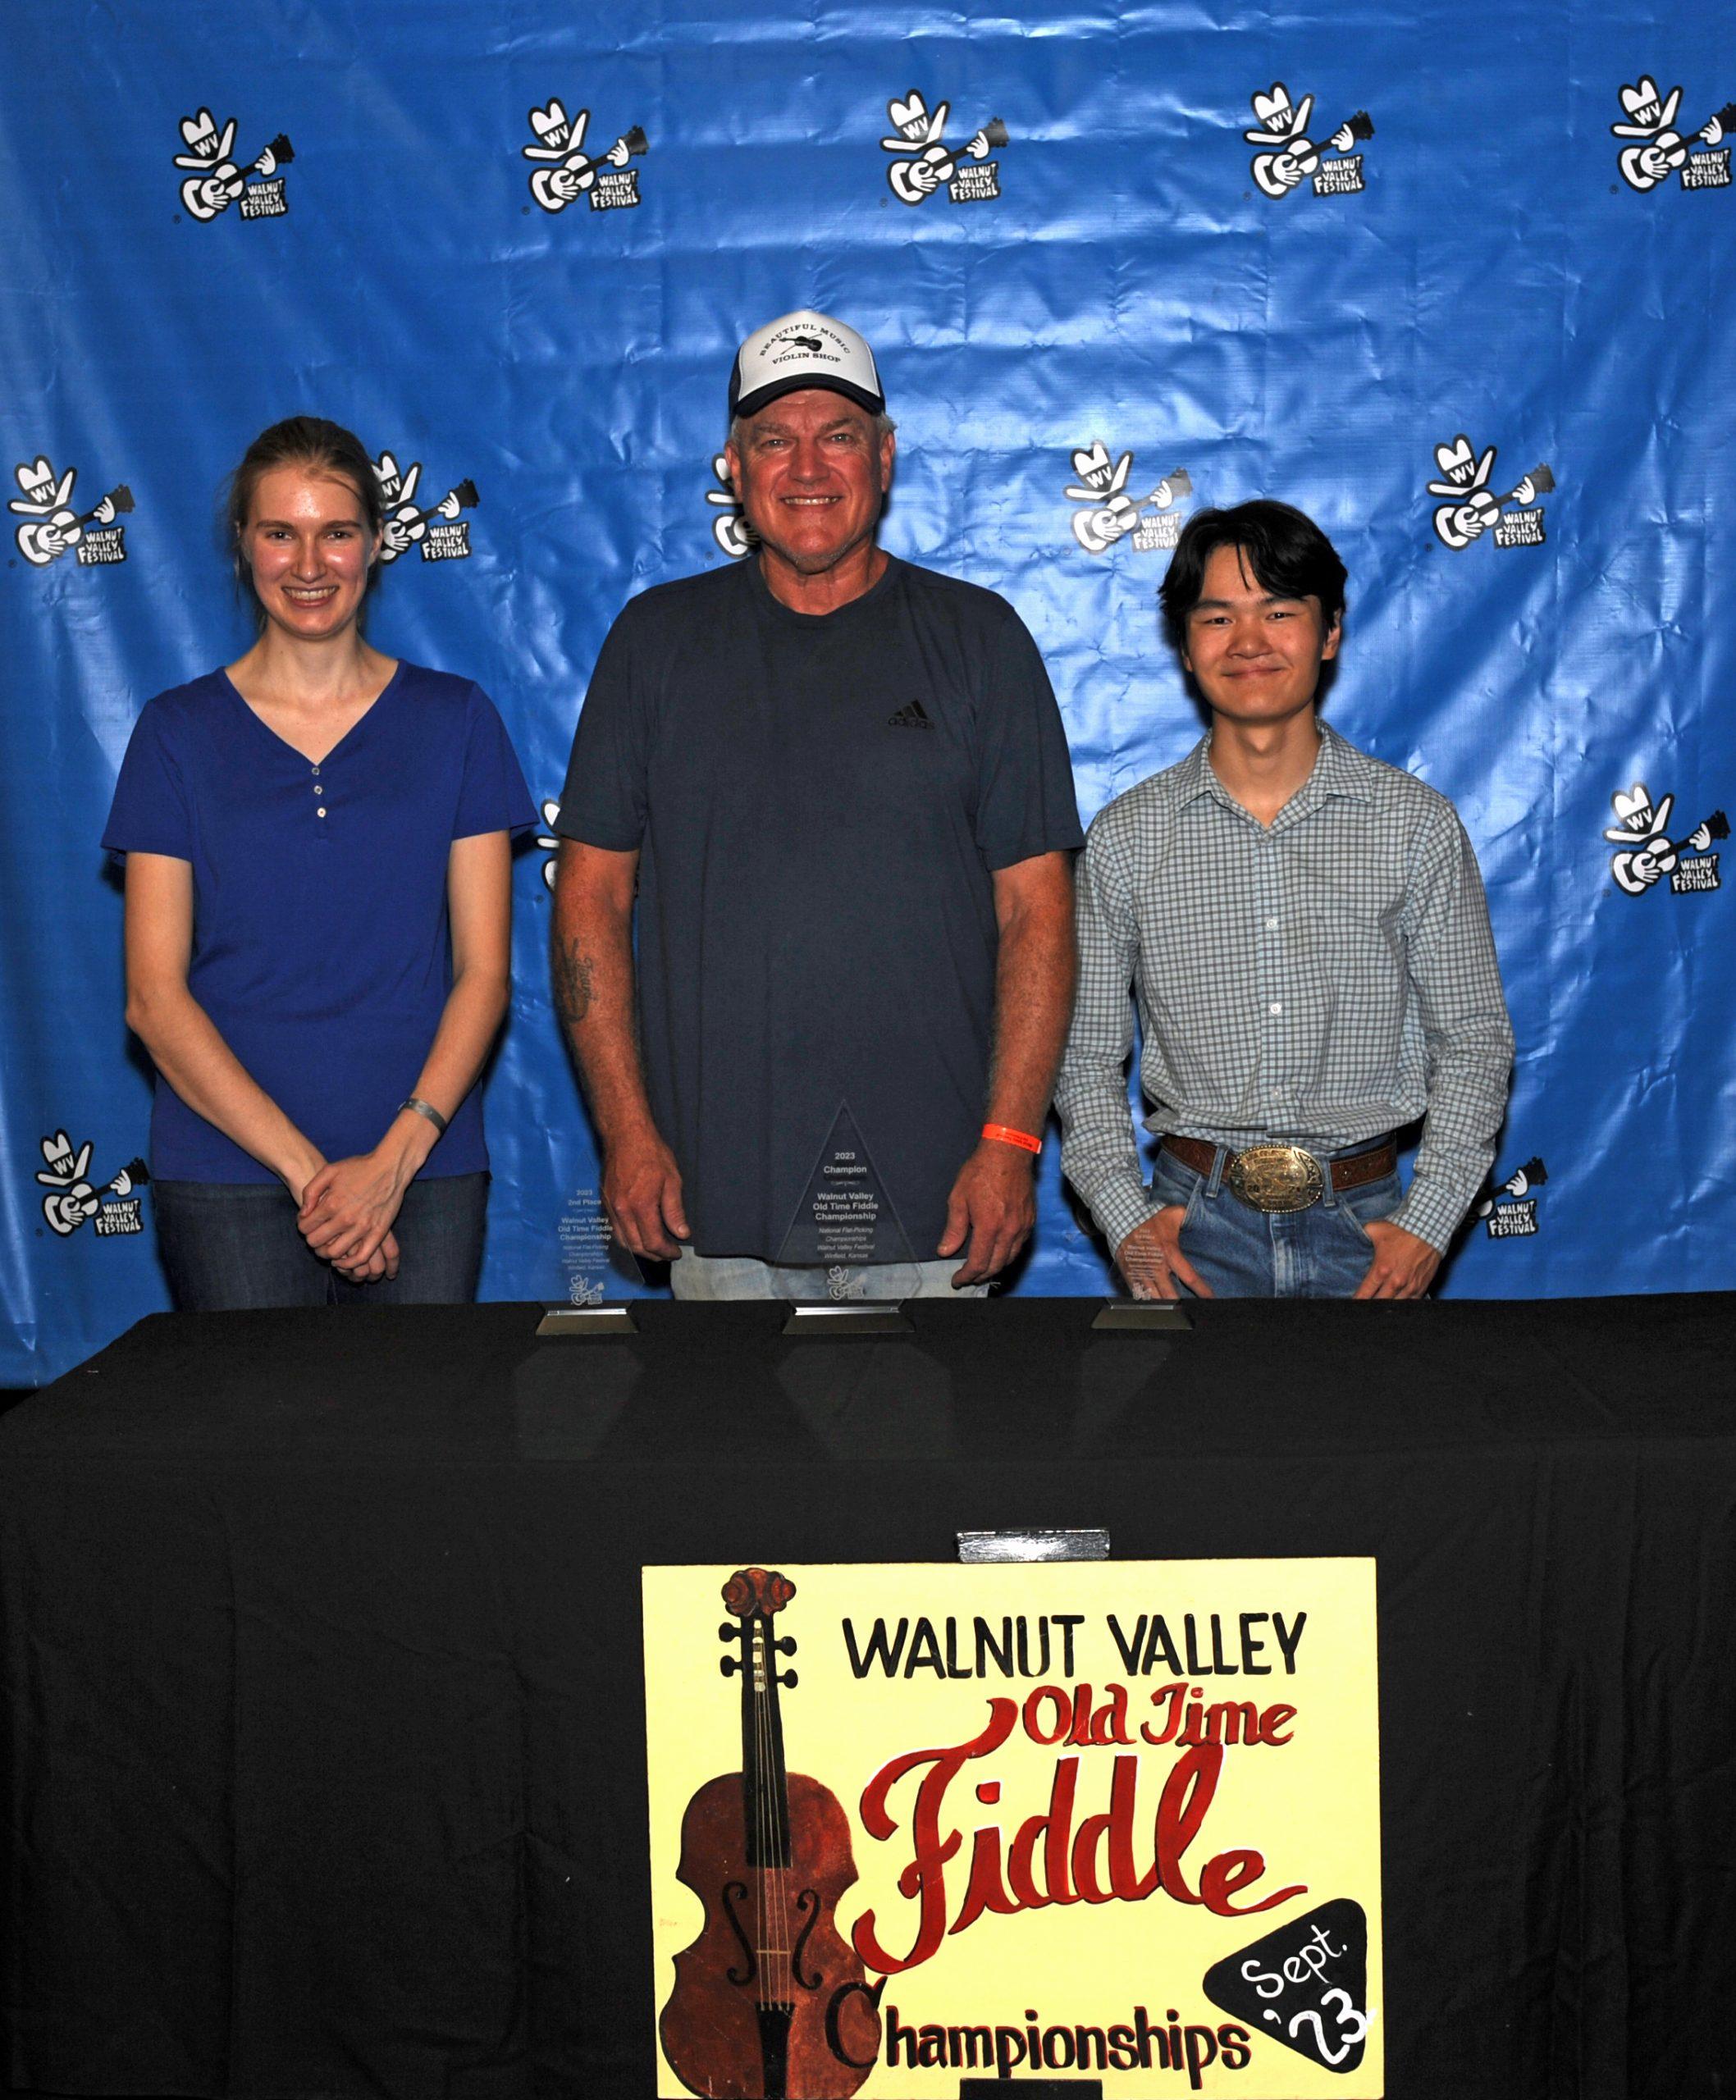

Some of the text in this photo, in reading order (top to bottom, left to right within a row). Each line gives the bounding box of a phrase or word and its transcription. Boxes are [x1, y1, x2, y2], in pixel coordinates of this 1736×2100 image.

[1267, 109, 1292, 132] WV
[1634, 102, 1661, 125] WV
[902, 116, 928, 139] WV
[544, 125, 569, 148] WV
[194, 134, 218, 157] WV
[1323, 156, 1361, 172] WALNUT
[1690, 149, 1729, 165] WALNUT
[958, 162, 996, 179] WALNUT
[1323, 170, 1357, 182] VALLEY
[1690, 162, 1725, 176] VALLEY
[599, 171, 637, 187] WALNUT
[958, 176, 992, 189] VALLEY
[1314, 176, 1363, 194] FESTIVAL
[1682, 170, 1730, 187] FESTIVAL
[248, 179, 283, 195] WALNUT
[599, 185, 632, 196] VALLEY
[950, 183, 998, 200] FESTIVAL
[248, 193, 280, 205] VALLEY
[591, 190, 638, 208] FESTIVAL
[240, 199, 286, 217] FESTIVAL
[760, 323, 852, 357] BEAUTIFUL MUSIC
[772, 352, 841, 365] VIOLIN SHOP
[1086, 466, 1112, 489] WV
[1450, 461, 1474, 484] WV
[30, 482, 56, 503] WV
[1141, 513, 1179, 528] WALNUT
[1504, 509, 1542, 524] WALNUT
[86, 527, 122, 543] WALNUT
[429, 523, 467, 538] WALNUT
[1141, 526, 1175, 539] VALLEY
[1504, 523, 1537, 534] VALLEY
[430, 536, 462, 548] VALLEY
[1496, 529, 1542, 546] FESTIVAL
[86, 541, 118, 552] VALLEY
[422, 542, 468, 559] FESTIVAL
[78, 547, 124, 564] FESTIVAL
[1627, 809, 1652, 831] WV
[1680, 855, 1717, 870] WALNUT
[1672, 874, 1718, 891] FESTIVAL
[1680, 869, 1712, 881] VALLEY
[834, 1152, 856, 1160] 2023
[53, 1155, 74, 1176] WV
[824, 1165, 867, 1175] Champion
[817, 1192, 874, 1201] Walnut Valley
[103, 1200, 139, 1214] WALNUT
[813, 1202, 879, 1210] Old Time Fiddle
[1497, 1201, 1535, 1216] WALNUT
[103, 1212, 135, 1224] VALLEY
[815, 1212, 876, 1221] Championship
[1497, 1213, 1530, 1226] VALLEY
[96, 1218, 140, 1234] FESTIVAL
[1489, 1220, 1536, 1235] FESTIVAL
[841, 1610, 1307, 1682] WALNUT VALLEY
[1022, 1682, 1298, 1747] Old Time
[850, 1696, 1309, 1975] Fiddle
[1240, 1924, 1348, 1998] Sept.
[825, 1975, 1251, 2090] Championships
[1263, 1988, 1368, 2065] '23
